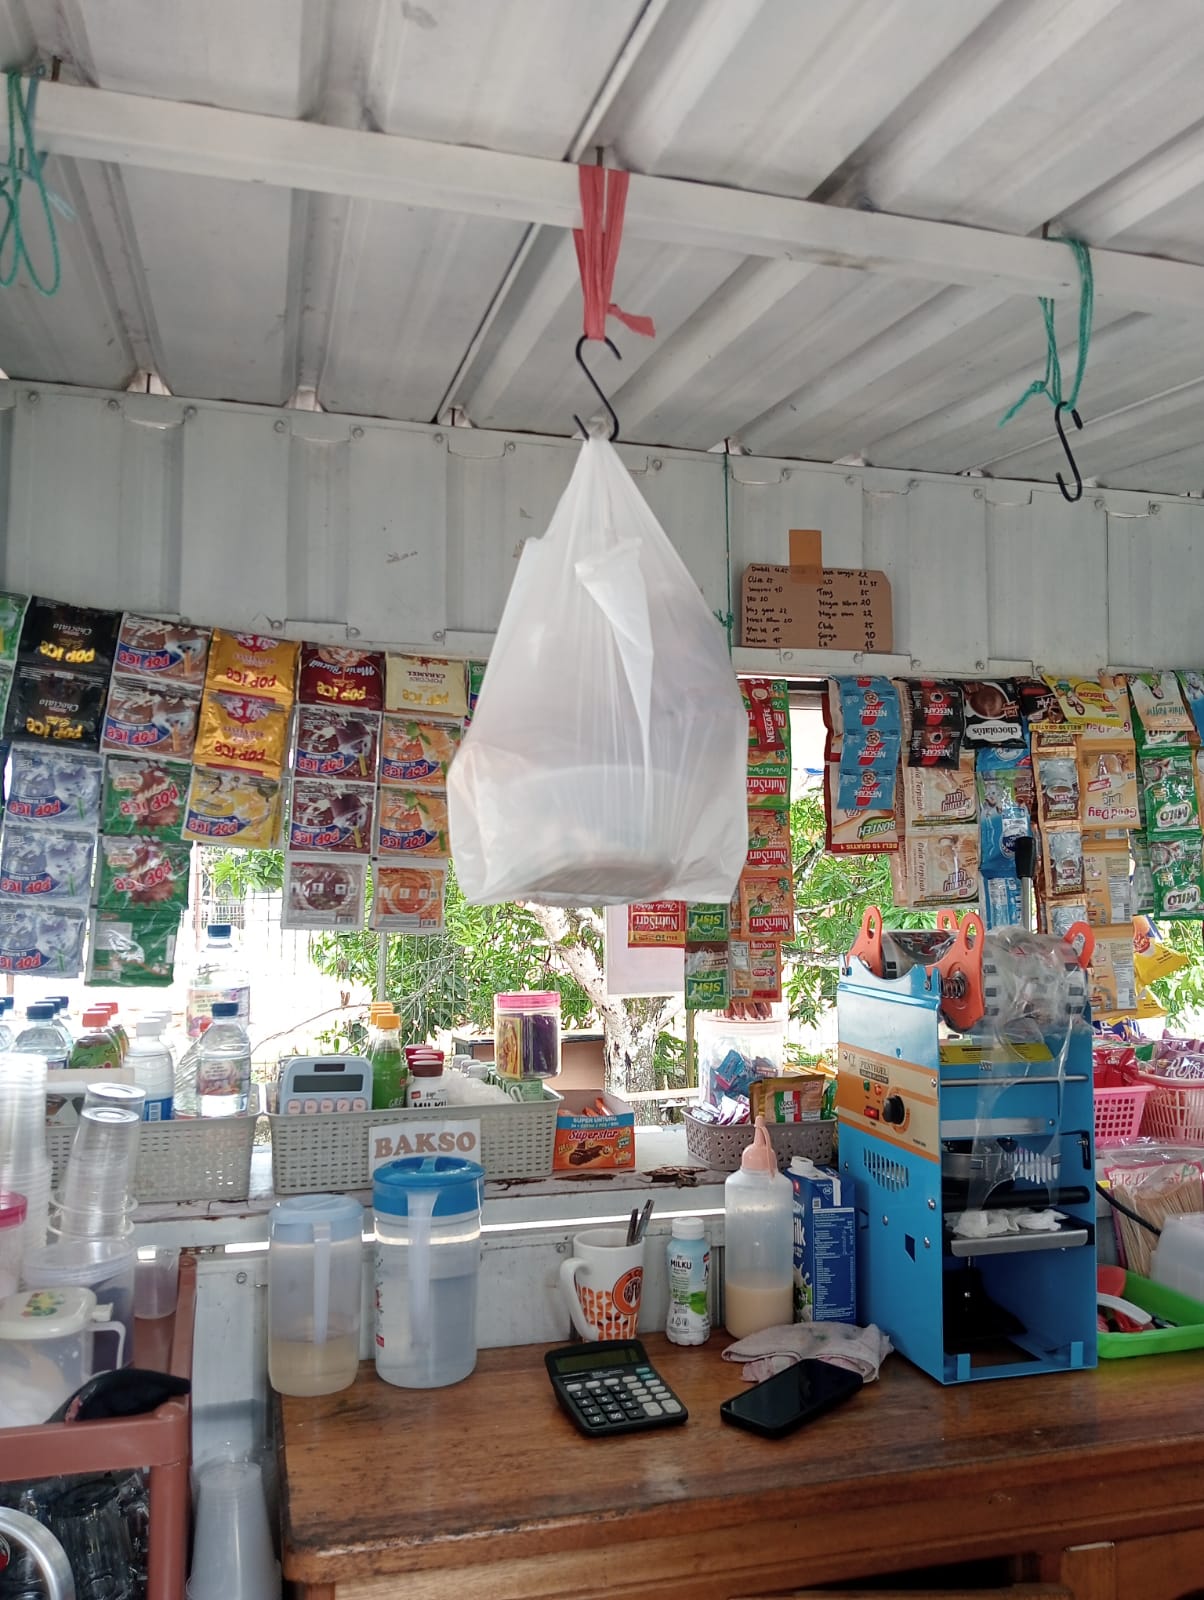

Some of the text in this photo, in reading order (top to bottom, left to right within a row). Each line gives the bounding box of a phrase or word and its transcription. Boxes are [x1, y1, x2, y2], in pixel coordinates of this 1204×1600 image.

[1088, 806, 1109, 820] Day
[1160, 806, 1188, 821] MILO
[1168, 890, 1197, 906] MILO
[636, 916, 678, 931] NutriSari
[374, 1131, 476, 1159] BAKSO
[670, 1259, 692, 1270] MILKU
